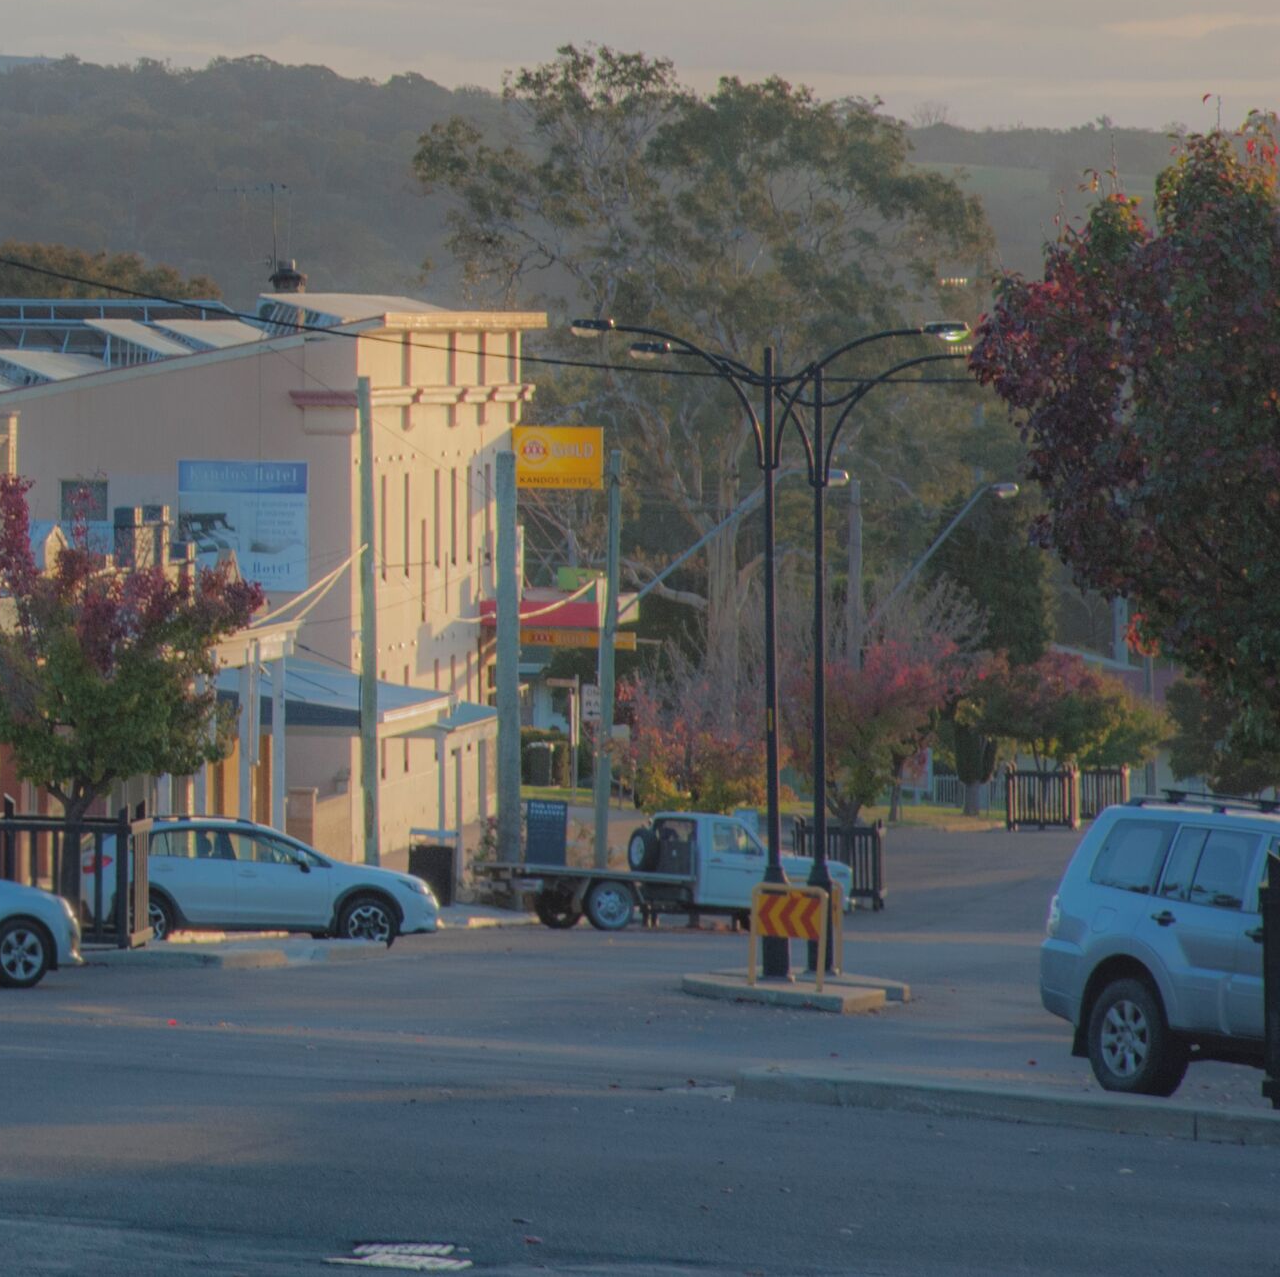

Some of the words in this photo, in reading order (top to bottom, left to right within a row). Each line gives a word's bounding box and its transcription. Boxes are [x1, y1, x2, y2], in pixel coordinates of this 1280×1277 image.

[190, 465, 248, 482] Kandos
[255, 466, 297, 482] Hotel
[519, 475, 560, 485] KANDOS
[562, 476, 593, 486] HOTEL
